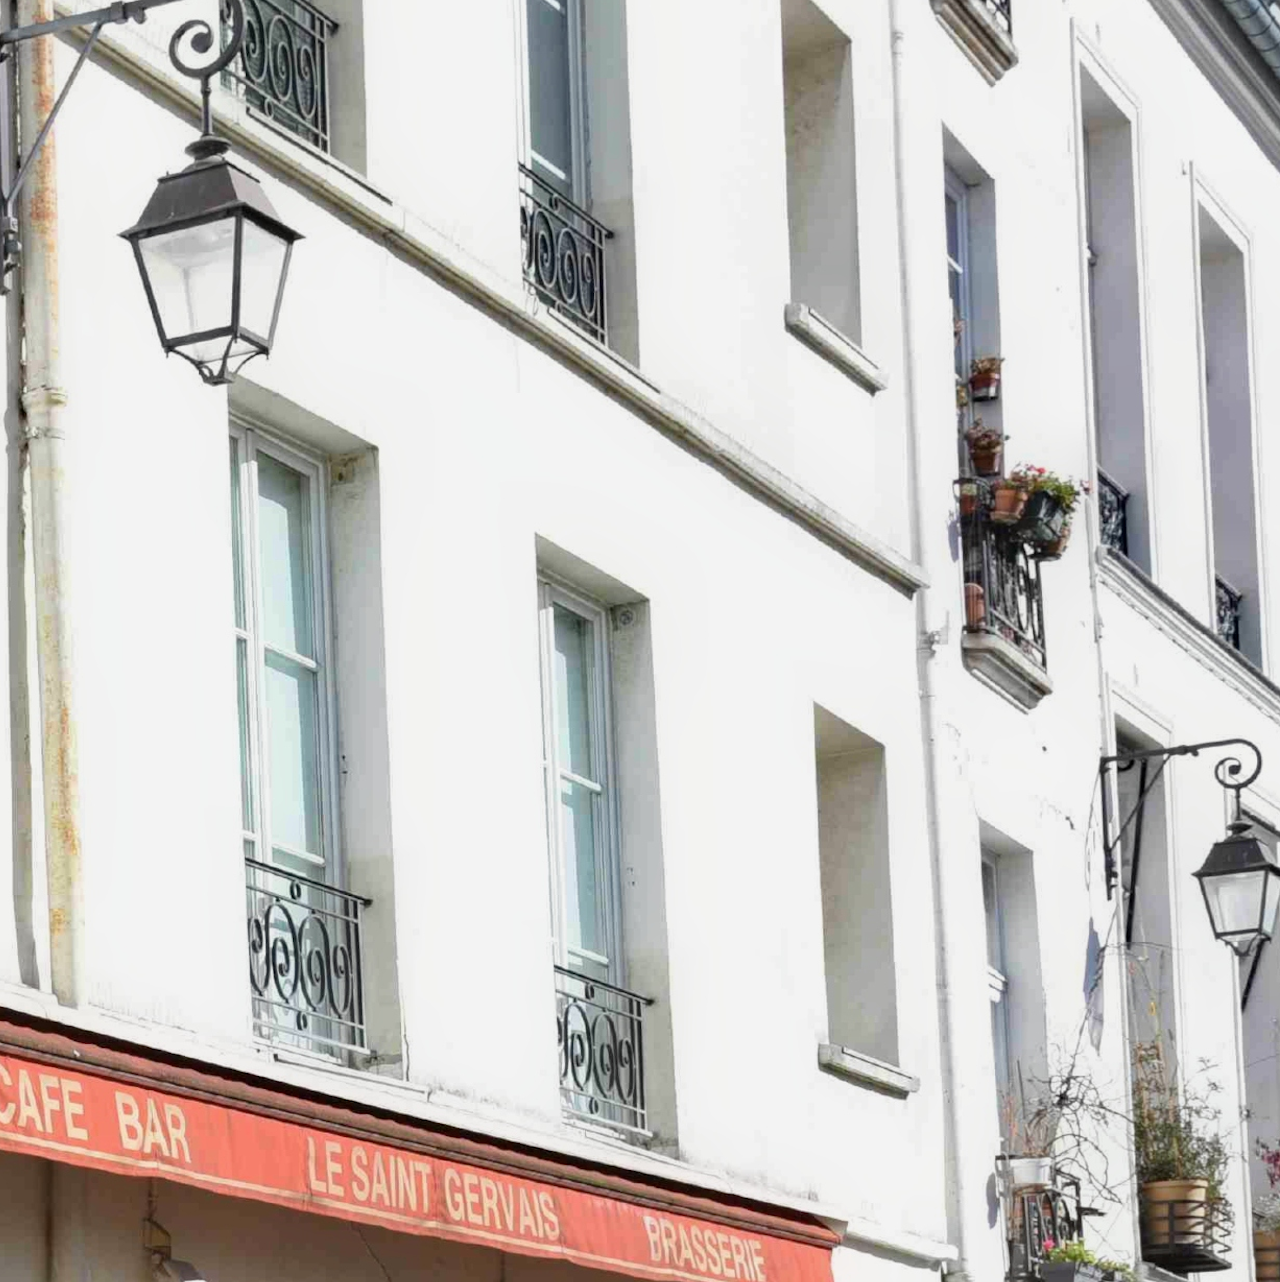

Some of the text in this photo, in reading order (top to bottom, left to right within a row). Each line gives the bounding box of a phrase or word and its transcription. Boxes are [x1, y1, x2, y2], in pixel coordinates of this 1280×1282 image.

[115, 1090, 192, 1163] BAR
[308, 1137, 560, 1241] LE SAINT GERVAIS
[643, 1215, 766, 1282] BRASSERIE
